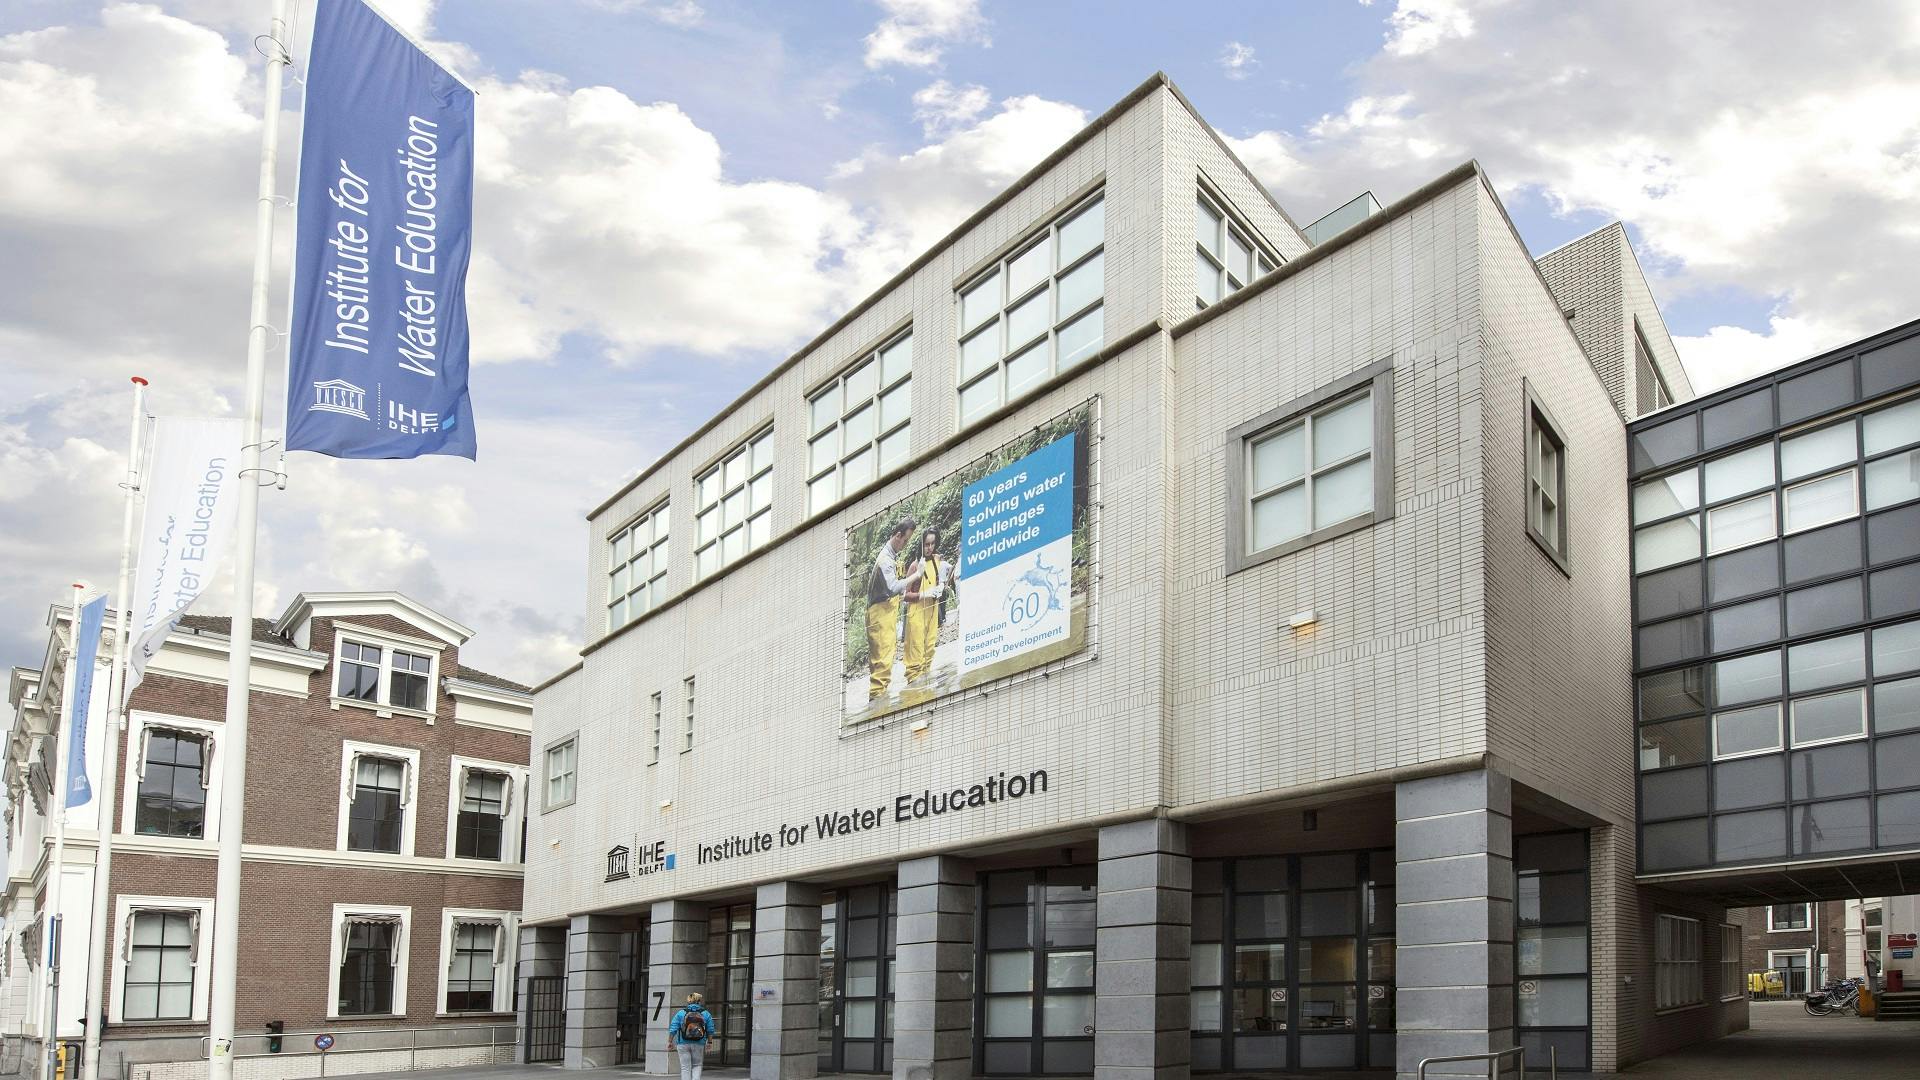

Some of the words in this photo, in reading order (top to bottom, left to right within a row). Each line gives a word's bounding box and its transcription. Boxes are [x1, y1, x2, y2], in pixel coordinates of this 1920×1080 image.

[329, 159, 369, 217] for
[396, 115, 438, 274] Education
[325, 221, 369, 354] Institute
[397, 280, 436, 377] Water
[389, 400, 438, 427] IHE
[389, 420, 438, 434] DELFT
[181, 457, 226, 561] Education
[968, 495, 1019, 527] solving
[1023, 471, 1066, 500] water
[969, 490, 984, 508] 60
[988, 471, 1027, 501] years
[968, 502, 1045, 546] challenges
[967, 525, 1040, 565] worldwide
[1010, 592, 1039, 624] 60
[964, 648, 1000, 666] Capacity
[1002, 626, 1063, 653] Development
[965, 620, 1007, 642] Education
[965, 634, 1004, 654] Research
[698, 832, 772, 865] Institute
[780, 820, 808, 847] for
[816, 805, 886, 839] Water
[895, 769, 1048, 823] Education
[639, 863, 664, 876] DELFT
[640, 841, 664, 865] IHE
[653, 992, 665, 1021] 7
